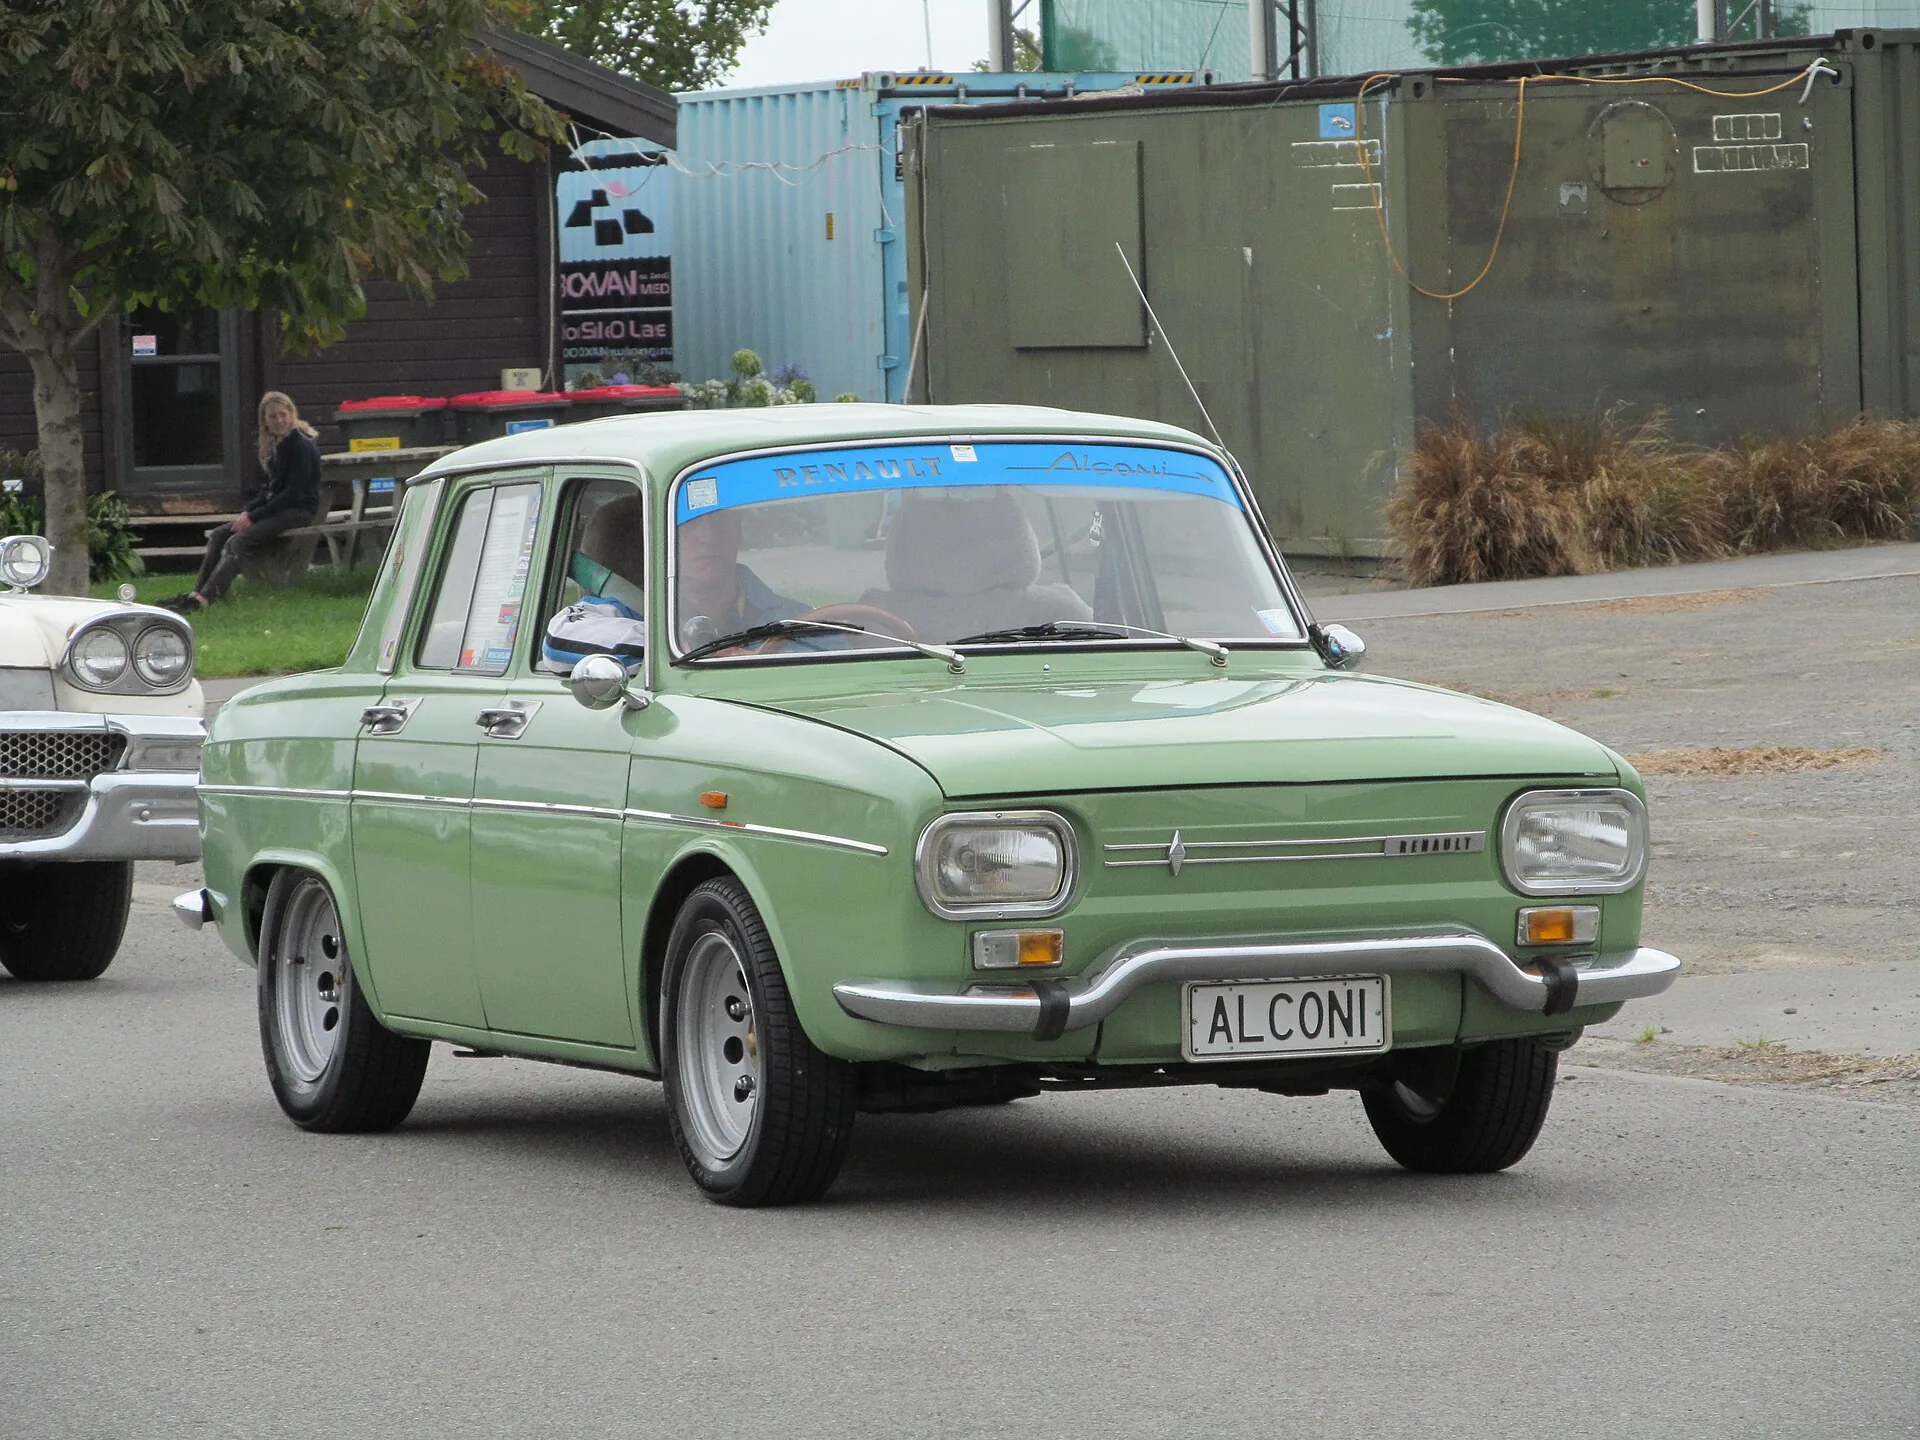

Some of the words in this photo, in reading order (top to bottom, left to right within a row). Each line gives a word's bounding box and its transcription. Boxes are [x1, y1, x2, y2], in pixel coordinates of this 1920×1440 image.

[773, 457, 943, 488] RENAULT
[1400, 837, 1471, 853] RENAULT
[1208, 989, 1366, 1043] ALCONI
